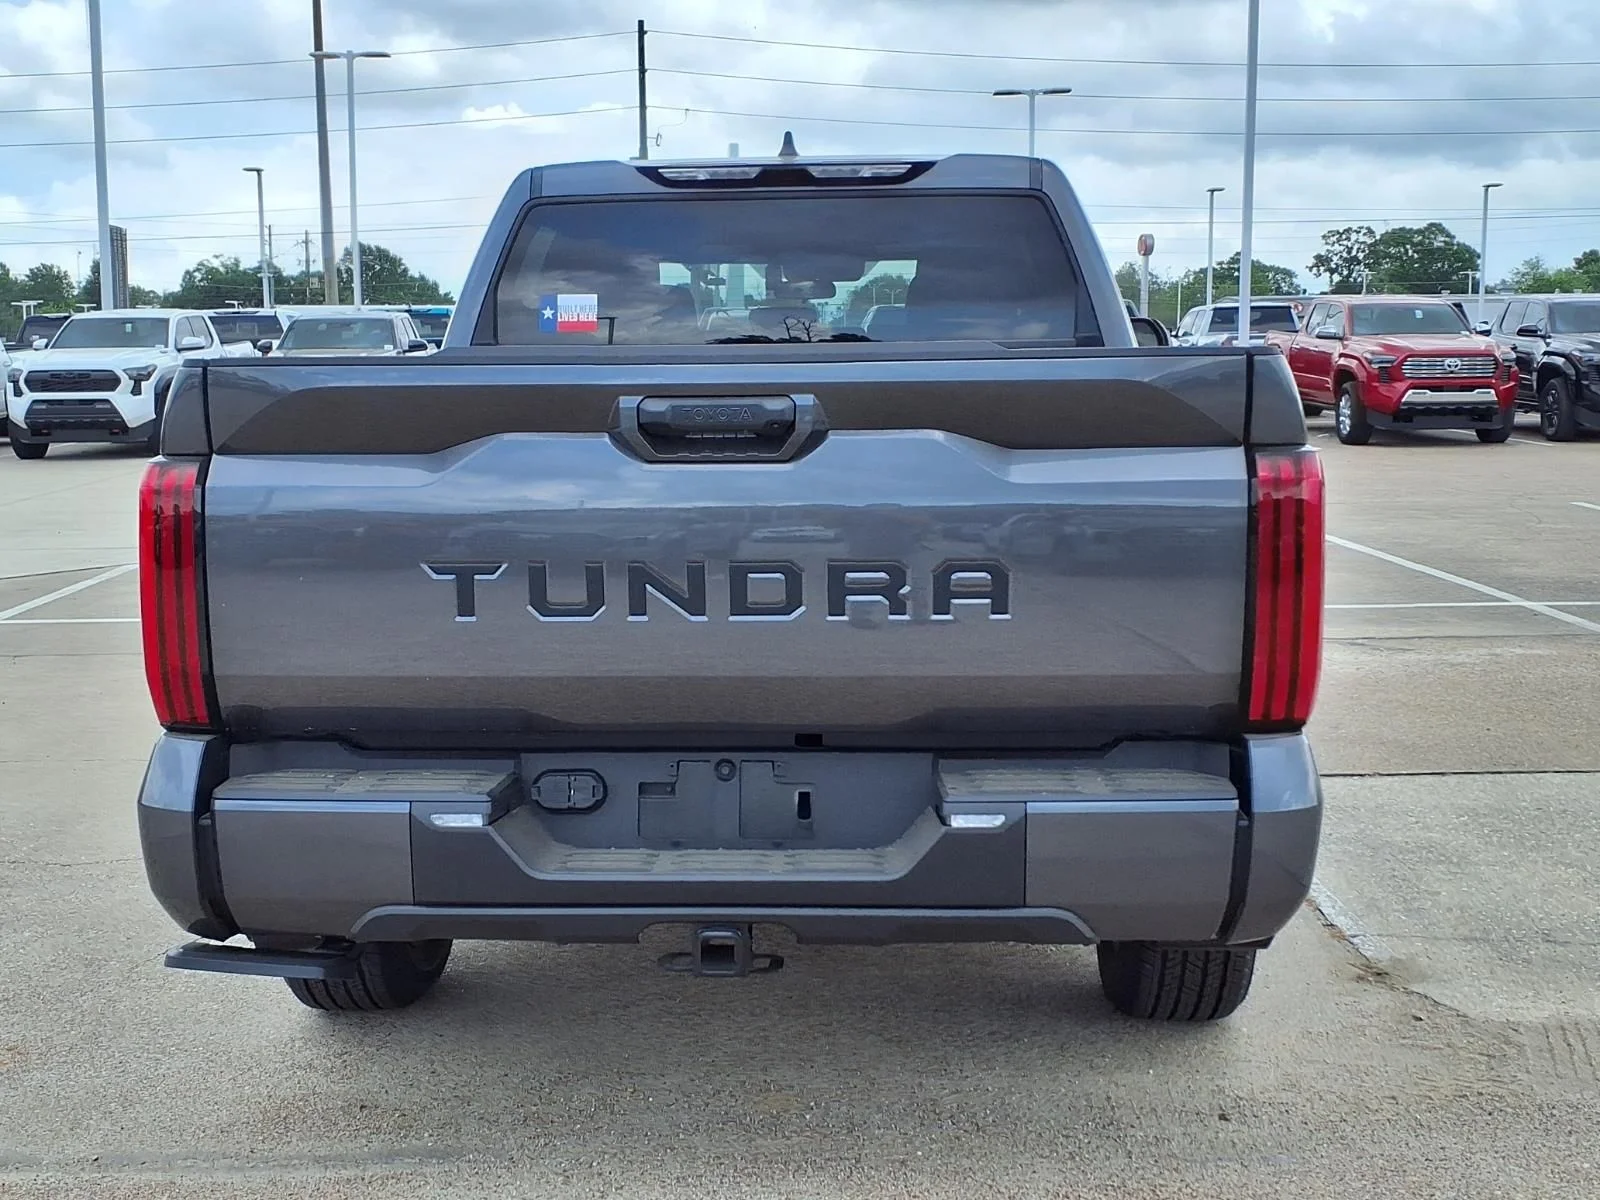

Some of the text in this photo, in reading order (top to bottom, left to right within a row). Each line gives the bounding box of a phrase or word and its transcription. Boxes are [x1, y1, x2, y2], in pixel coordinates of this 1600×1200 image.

[558, 312, 598, 322] LIVES HERE
[681, 407, 752, 422] TOYOTA
[419, 560, 1012, 622] TUNDRA
